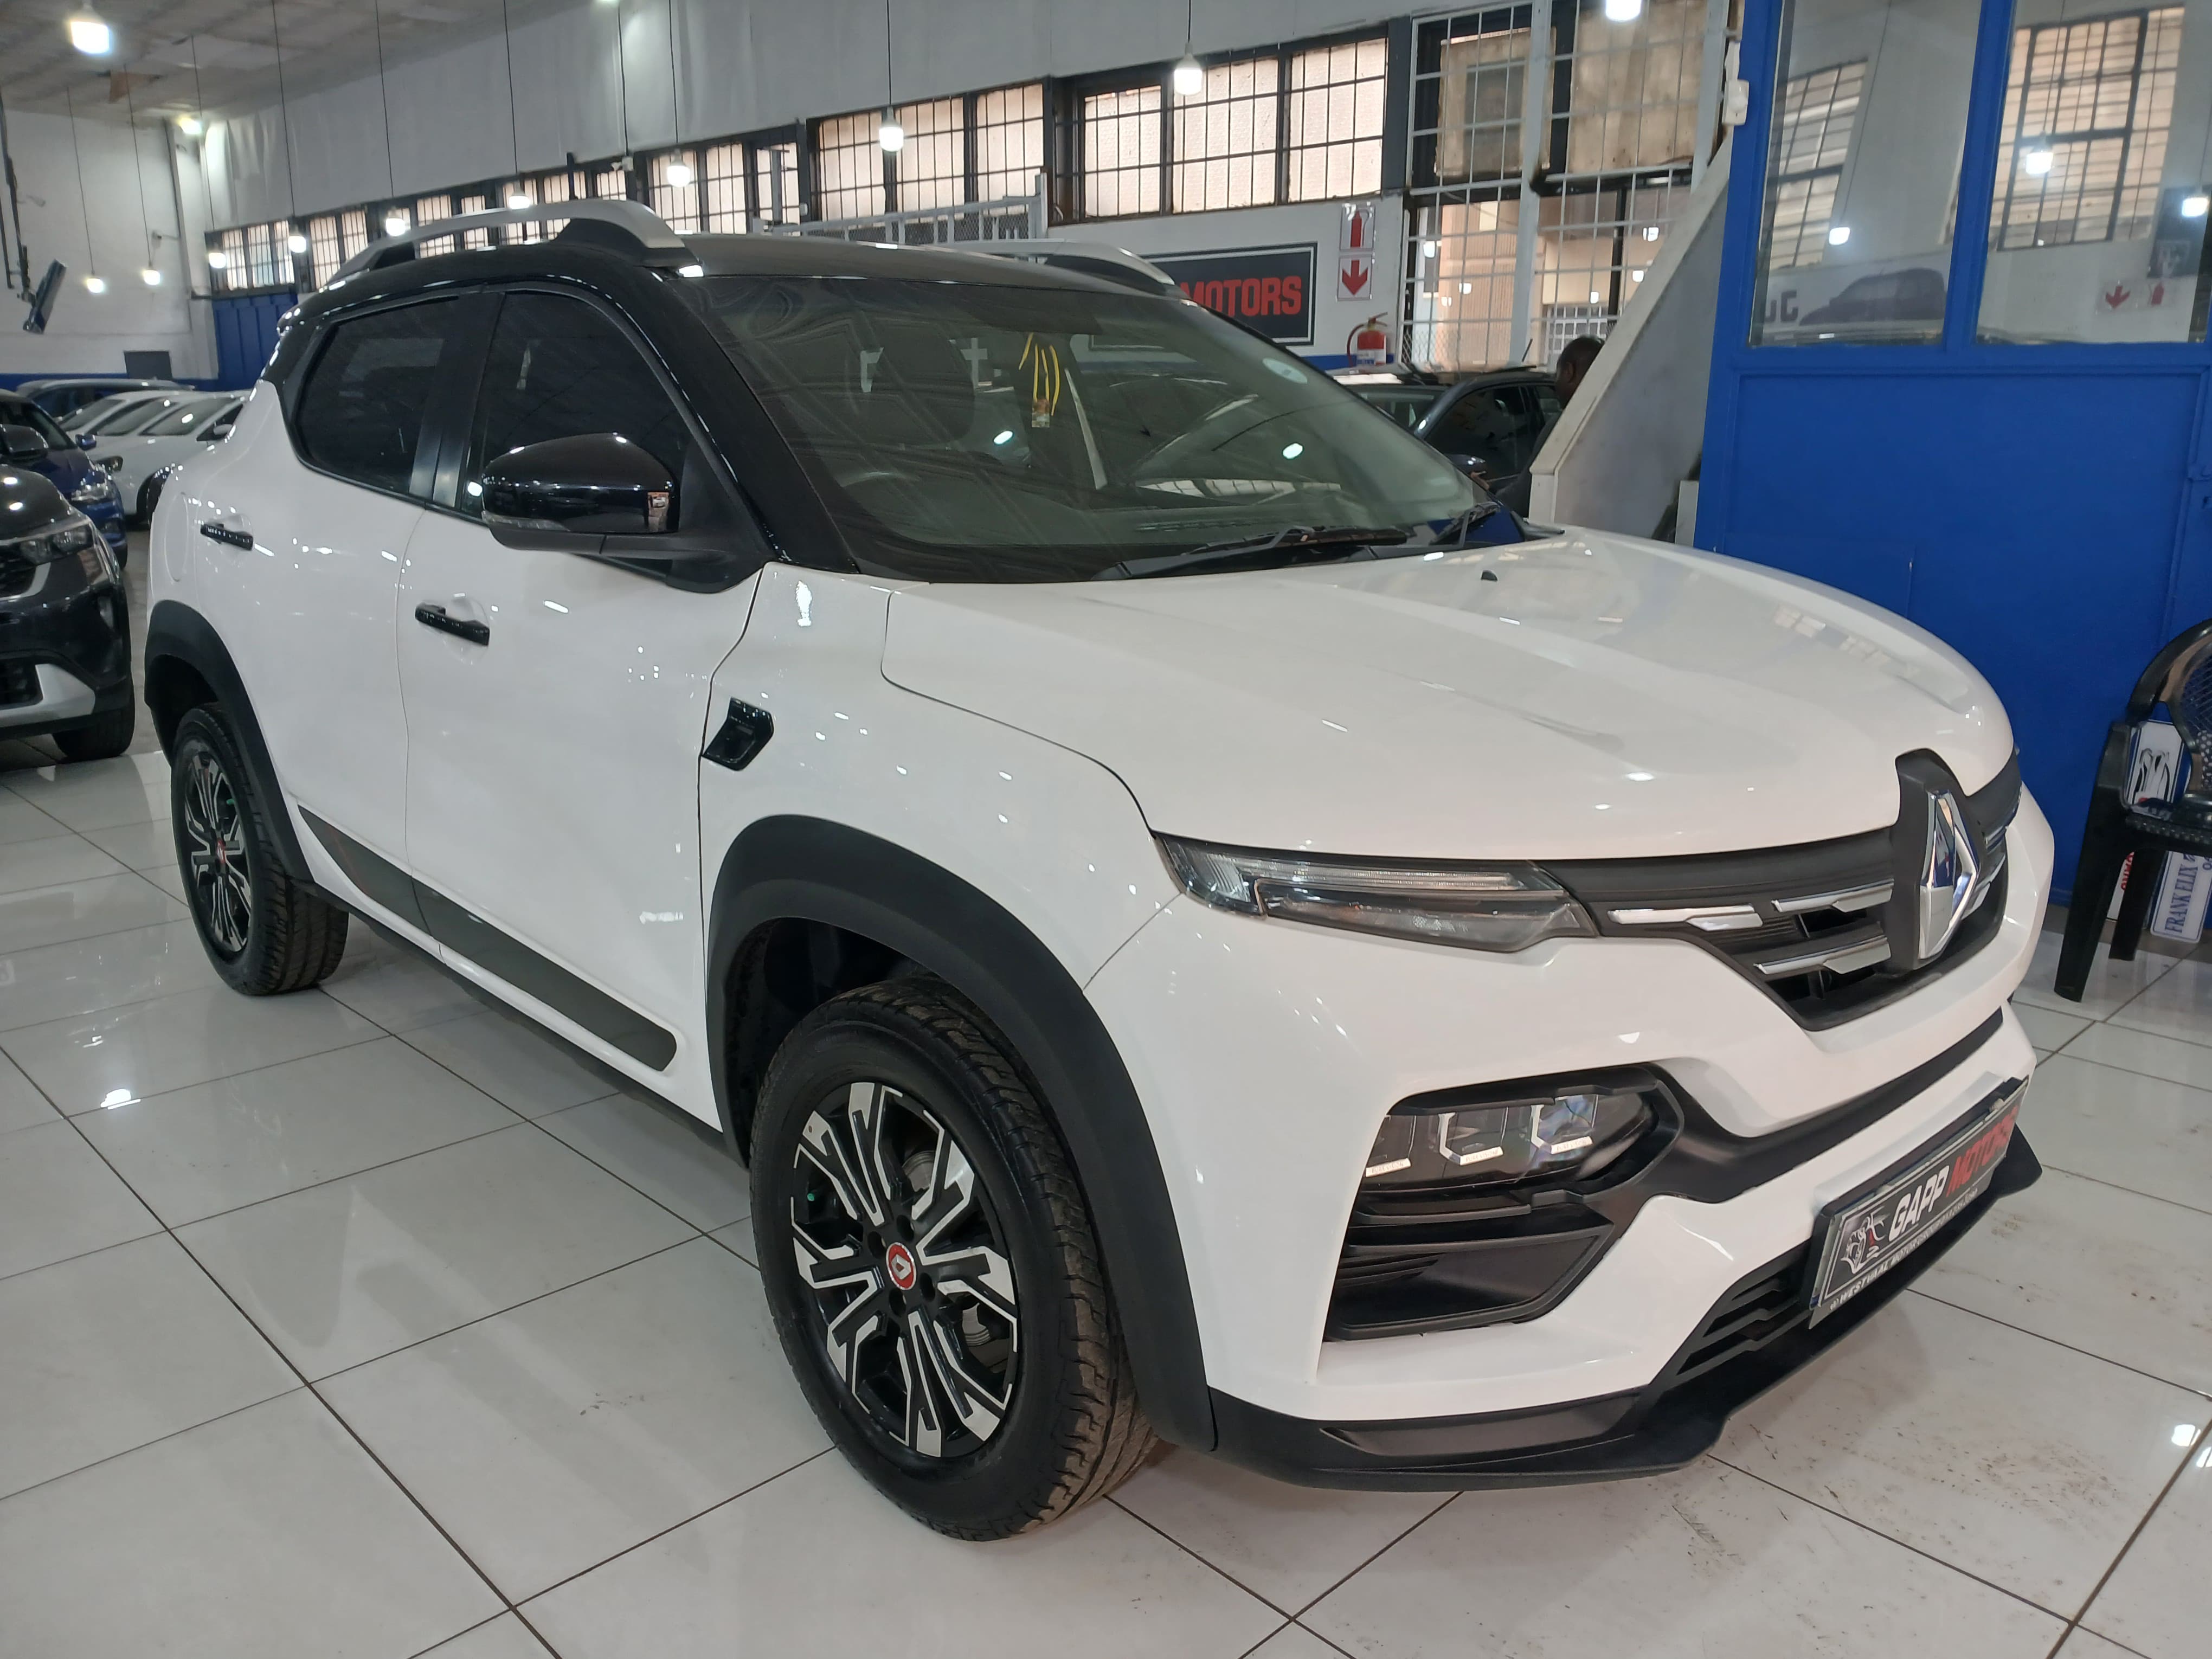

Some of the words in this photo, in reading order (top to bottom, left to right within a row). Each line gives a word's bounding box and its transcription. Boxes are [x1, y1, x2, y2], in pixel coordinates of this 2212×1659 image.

[1180, 276, 1302, 317] MOTORS
[2165, 893, 2191, 933] FRANK
[1889, 1165, 1950, 1242] GAPP
